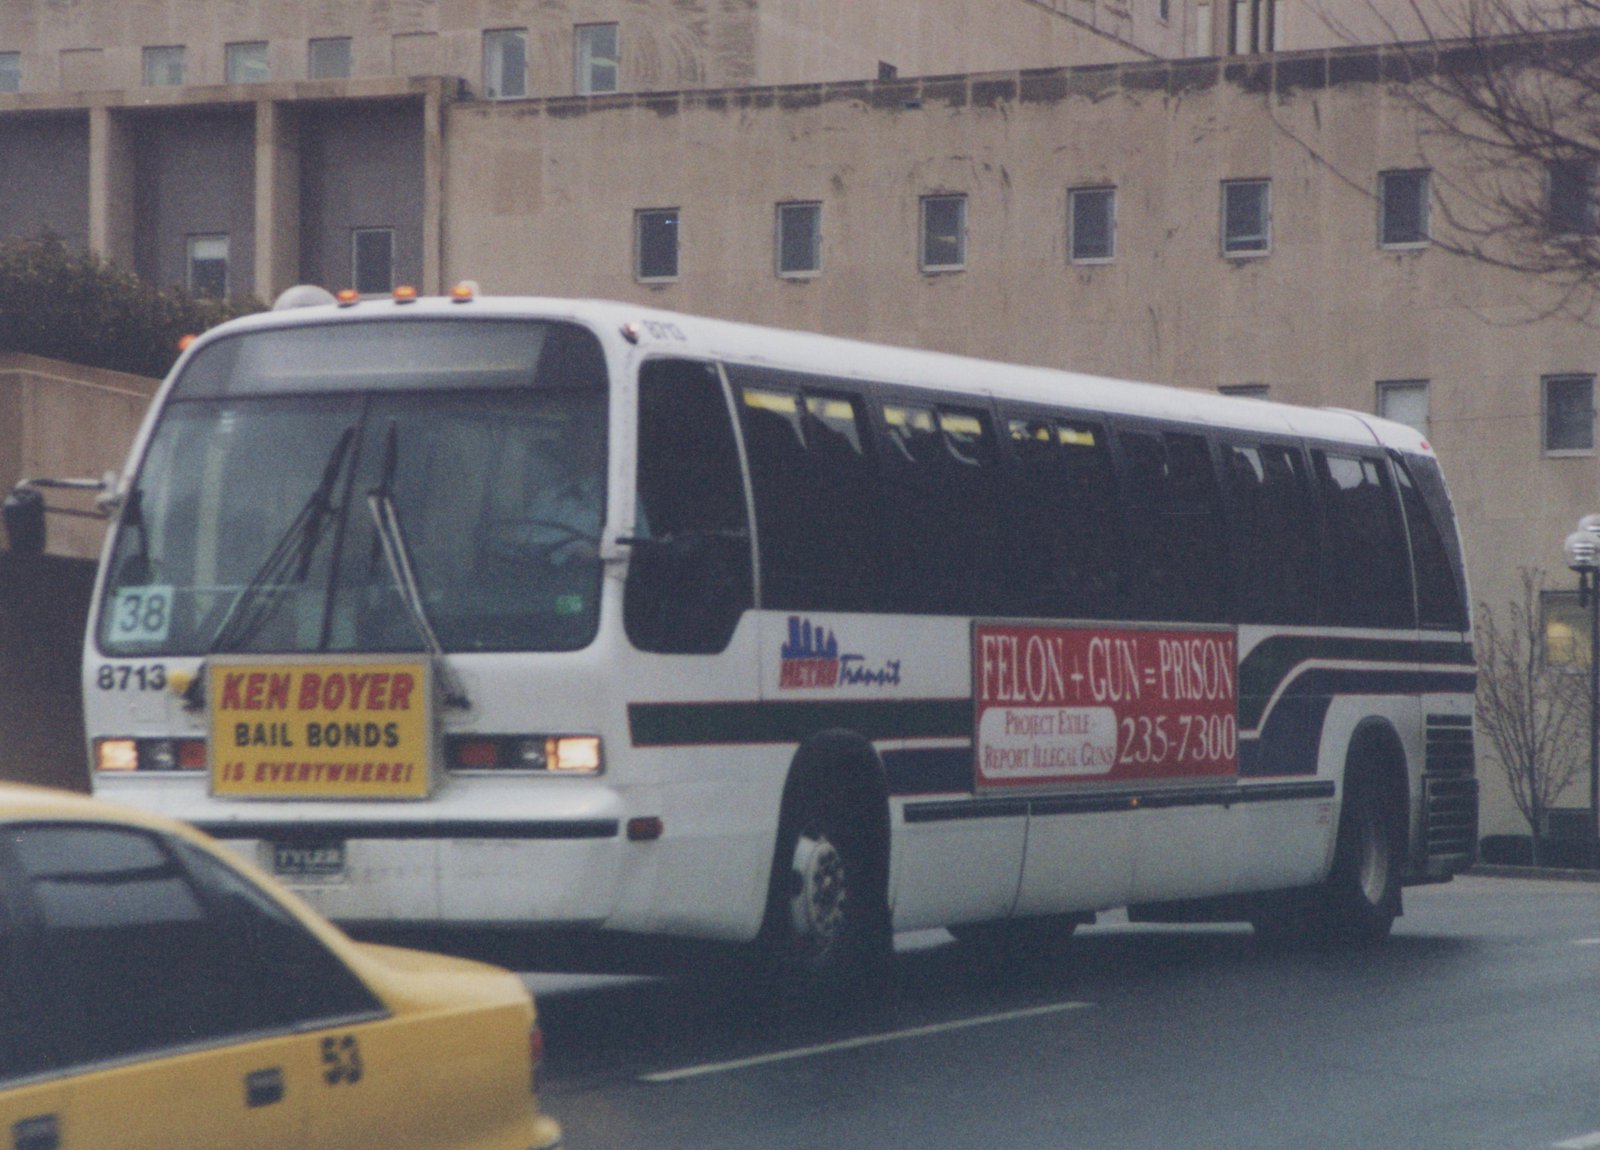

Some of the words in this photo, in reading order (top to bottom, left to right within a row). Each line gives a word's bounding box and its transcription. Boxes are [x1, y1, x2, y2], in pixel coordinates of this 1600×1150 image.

[119, 594, 169, 633] 38
[96, 664, 167, 691] 8713
[981, 634, 1066, 701] FELON
[1088, 636, 1140, 701] GUN
[1158, 638, 1234, 700] PRISON
[220, 672, 292, 711] KEN
[297, 672, 415, 711] BOYER
[235, 722, 293, 749] BAIL
[306, 721, 400, 749] BONDS
[1119, 713, 1237, 764] 235-7300
[222, 761, 246, 783] IS
[254, 761, 414, 783] EVERYWHERE!
